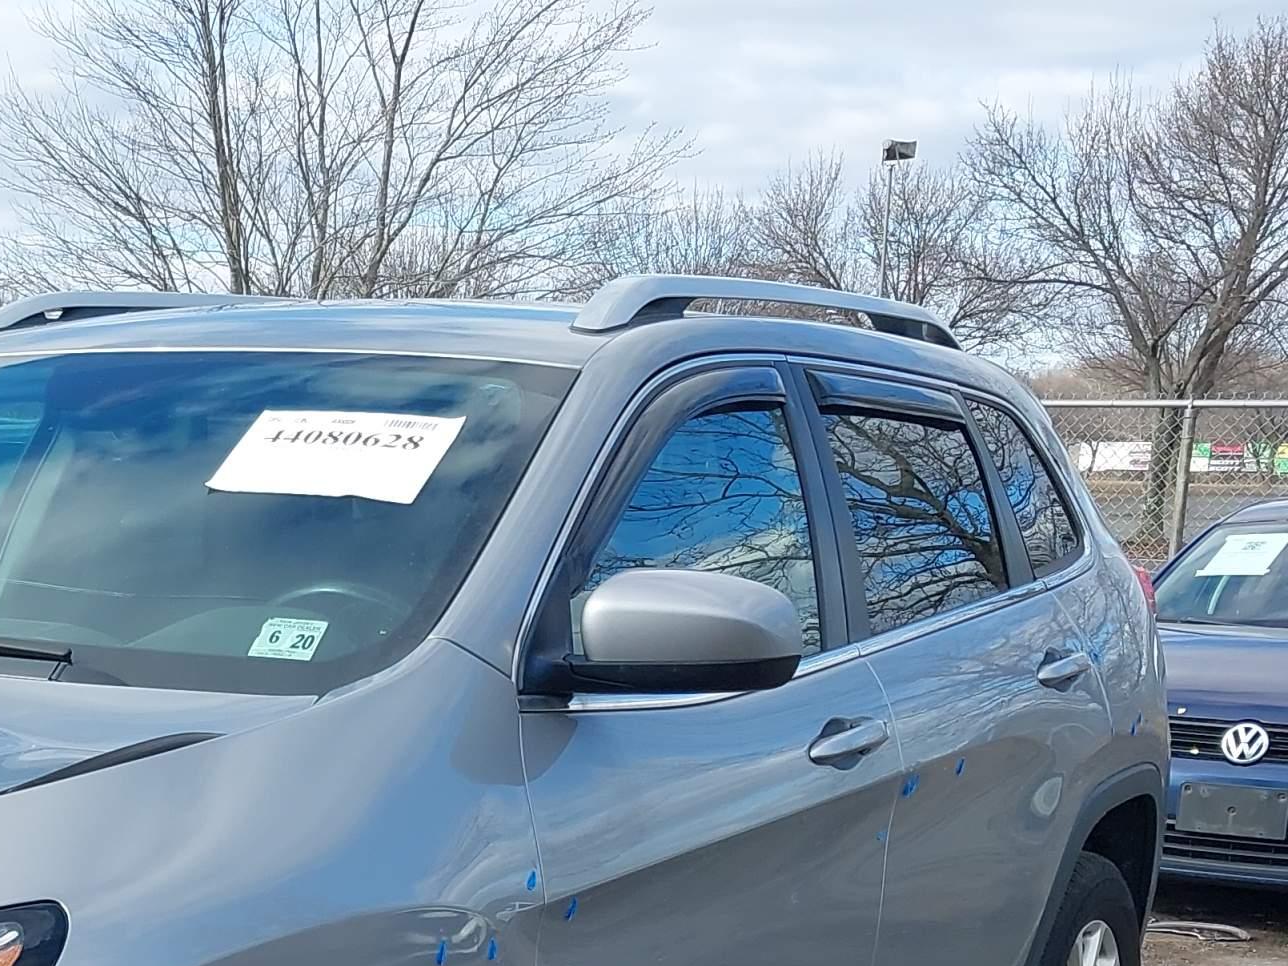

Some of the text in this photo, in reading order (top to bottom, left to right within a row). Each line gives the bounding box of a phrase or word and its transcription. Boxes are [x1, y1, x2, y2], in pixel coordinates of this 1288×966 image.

[264, 429, 424, 450] 44080628
[268, 630, 316, 650] 6 20
